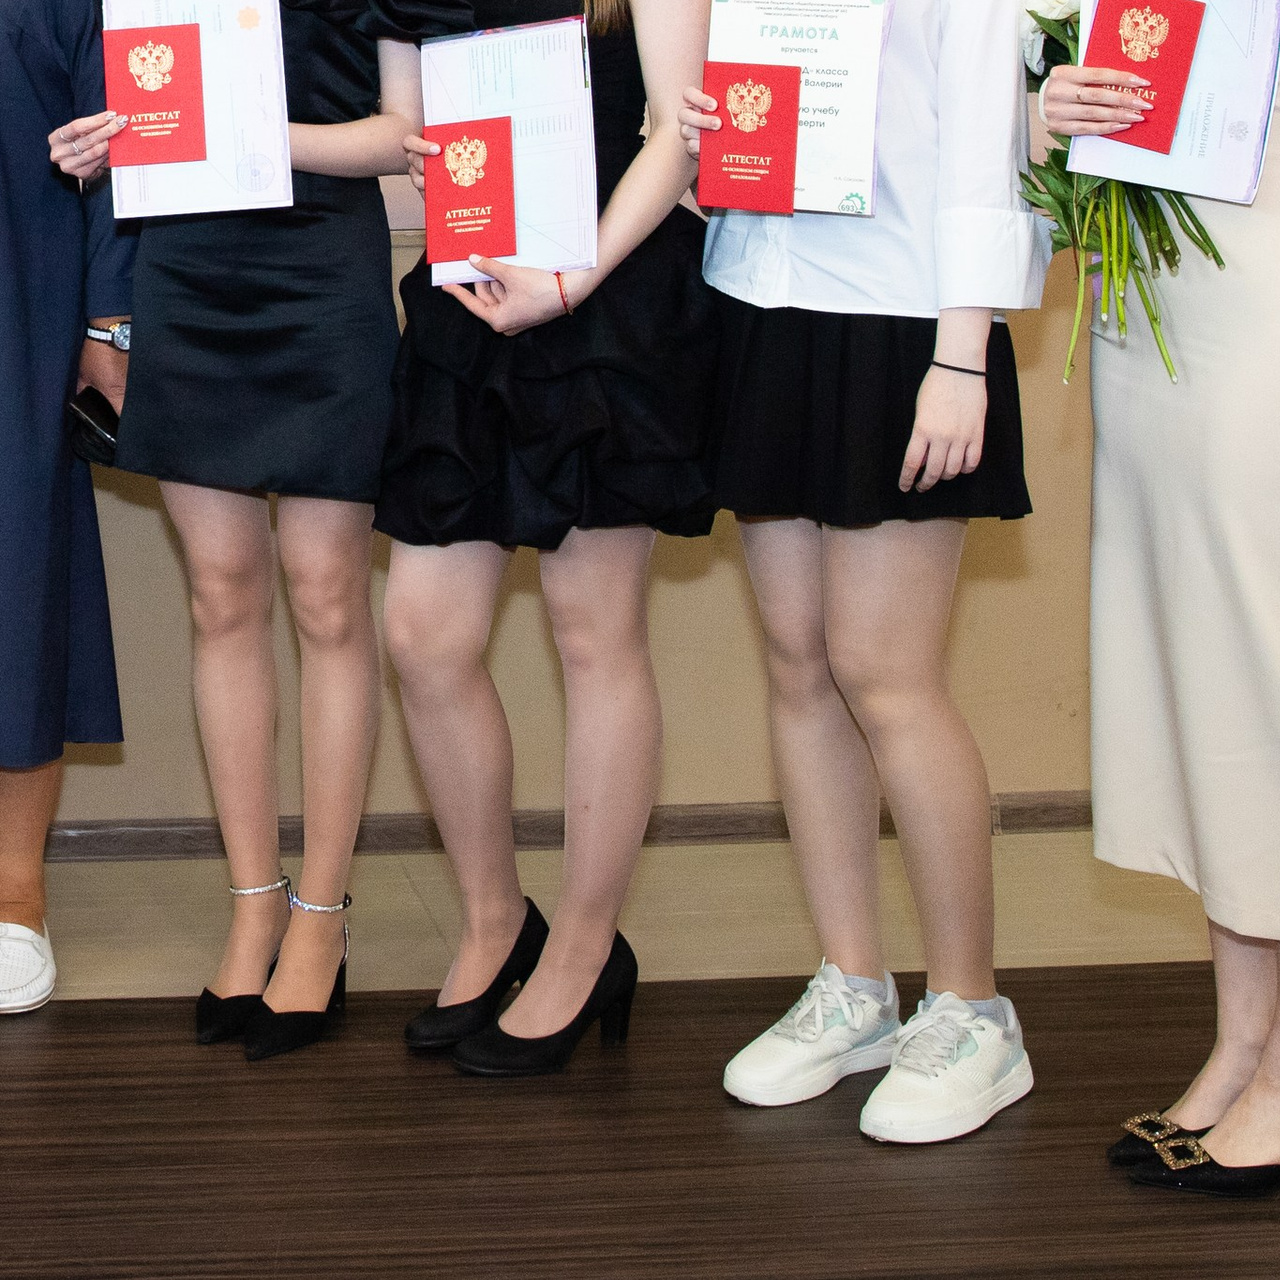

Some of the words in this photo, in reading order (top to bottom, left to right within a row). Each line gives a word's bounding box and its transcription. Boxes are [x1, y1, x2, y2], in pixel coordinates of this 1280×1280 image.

[759, 24, 839, 41] ГРАМОТА
[780, 46, 818, 54] вручается
[816, 68, 848, 76] класса
[804, 79, 843, 88] Валерии
[812, 106, 840, 116] учебу
[130, 110, 180, 123] АТТЕСТАТ
[721, 154, 772, 166] АТТЕСТАТ
[445, 205, 492, 220] АТТЕСТАТ
[840, 204, 855, 212] 693
